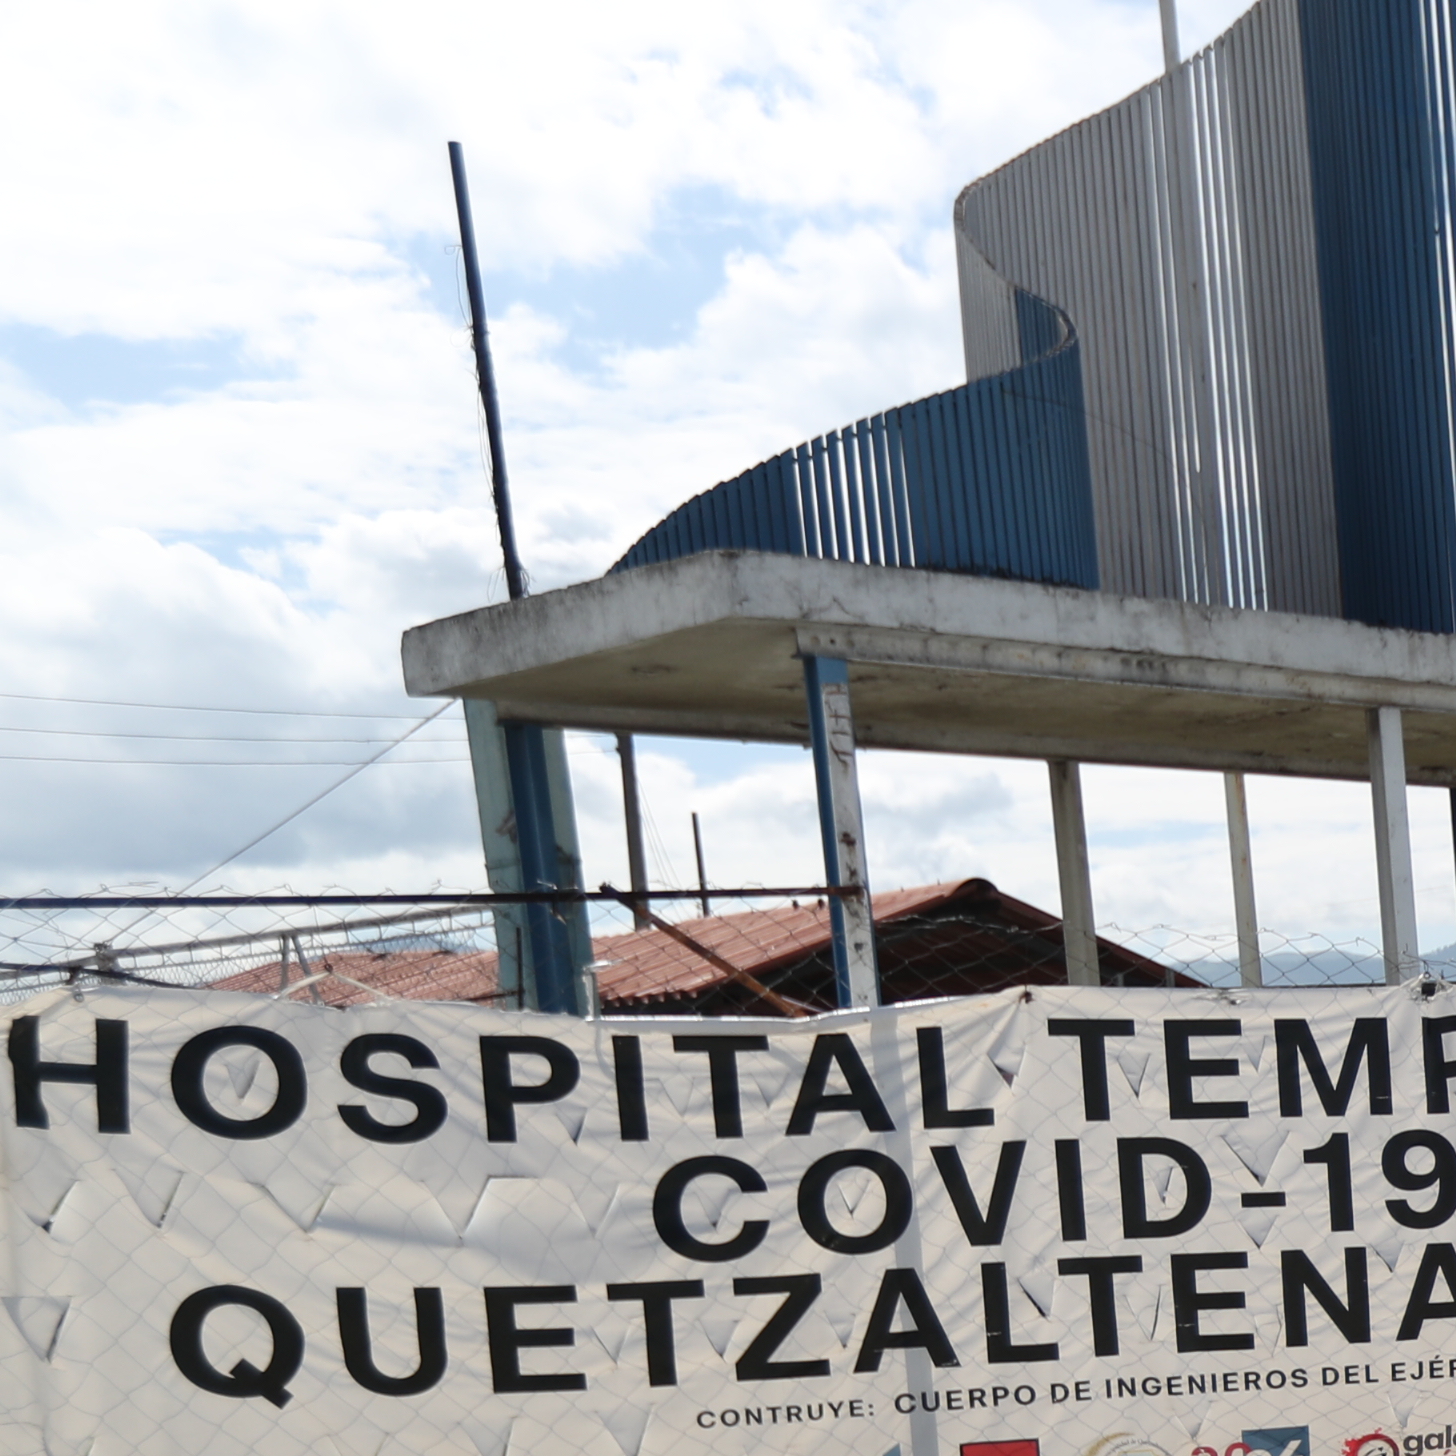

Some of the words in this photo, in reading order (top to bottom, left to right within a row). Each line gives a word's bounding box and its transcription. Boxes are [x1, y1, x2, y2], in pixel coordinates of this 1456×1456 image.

[8, 1016, 1000, 1144] HOSPITAL
[696, 1399, 876, 1429] CONTRUYE:
[893, 1384, 1037, 1415] CUERPO
[1050, 1379, 1093, 1404] DE
[1105, 1368, 1309, 1400] INGENIEROS
[1322, 1362, 1379, 1386] DEL
